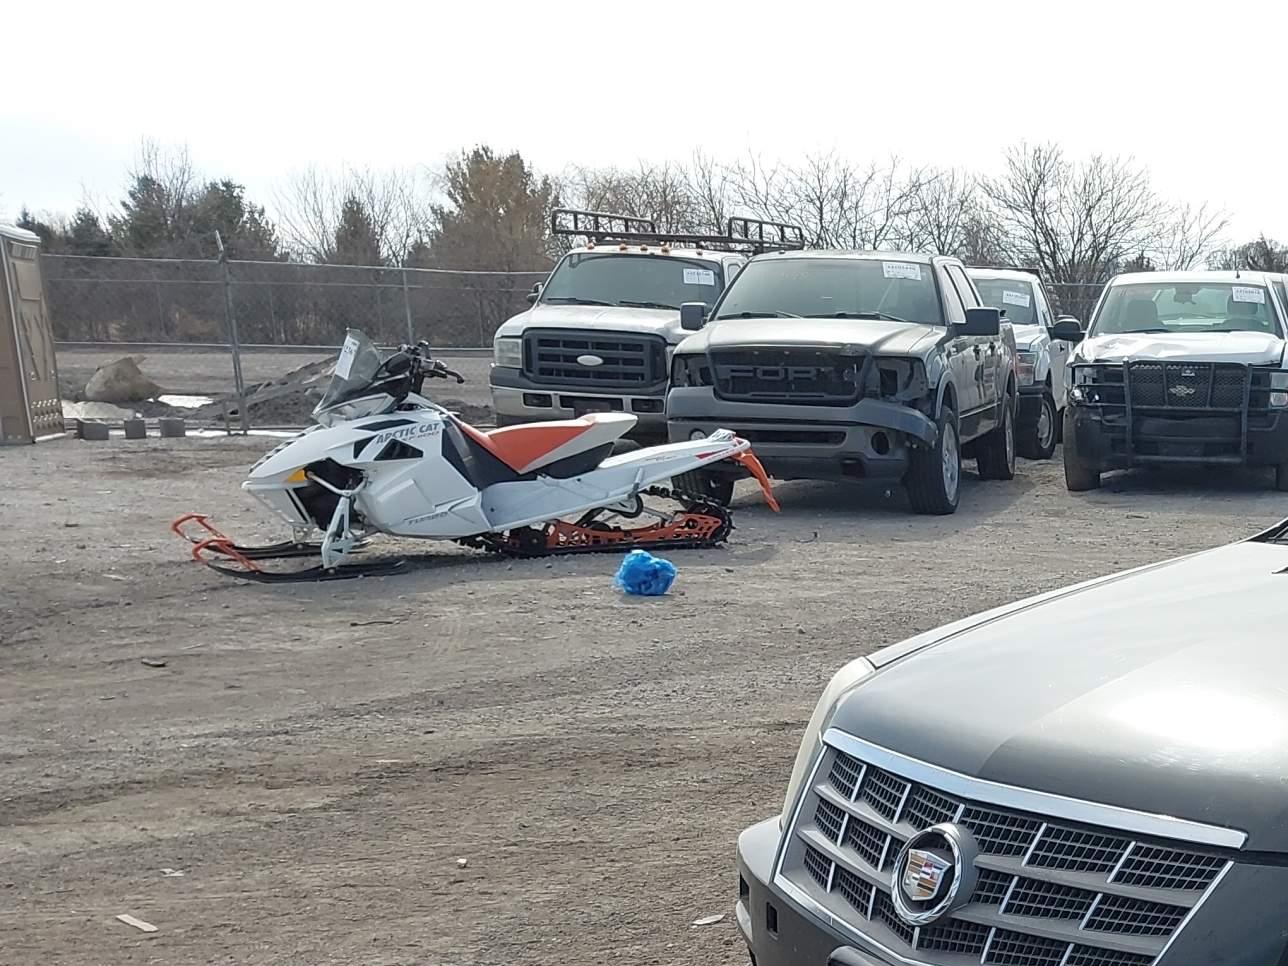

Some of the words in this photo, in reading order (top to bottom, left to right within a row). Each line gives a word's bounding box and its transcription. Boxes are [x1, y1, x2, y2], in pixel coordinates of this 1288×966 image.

[716, 365, 833, 381] FOR
[376, 426, 417, 444] ARCTIC
[419, 422, 440, 433] CAT
